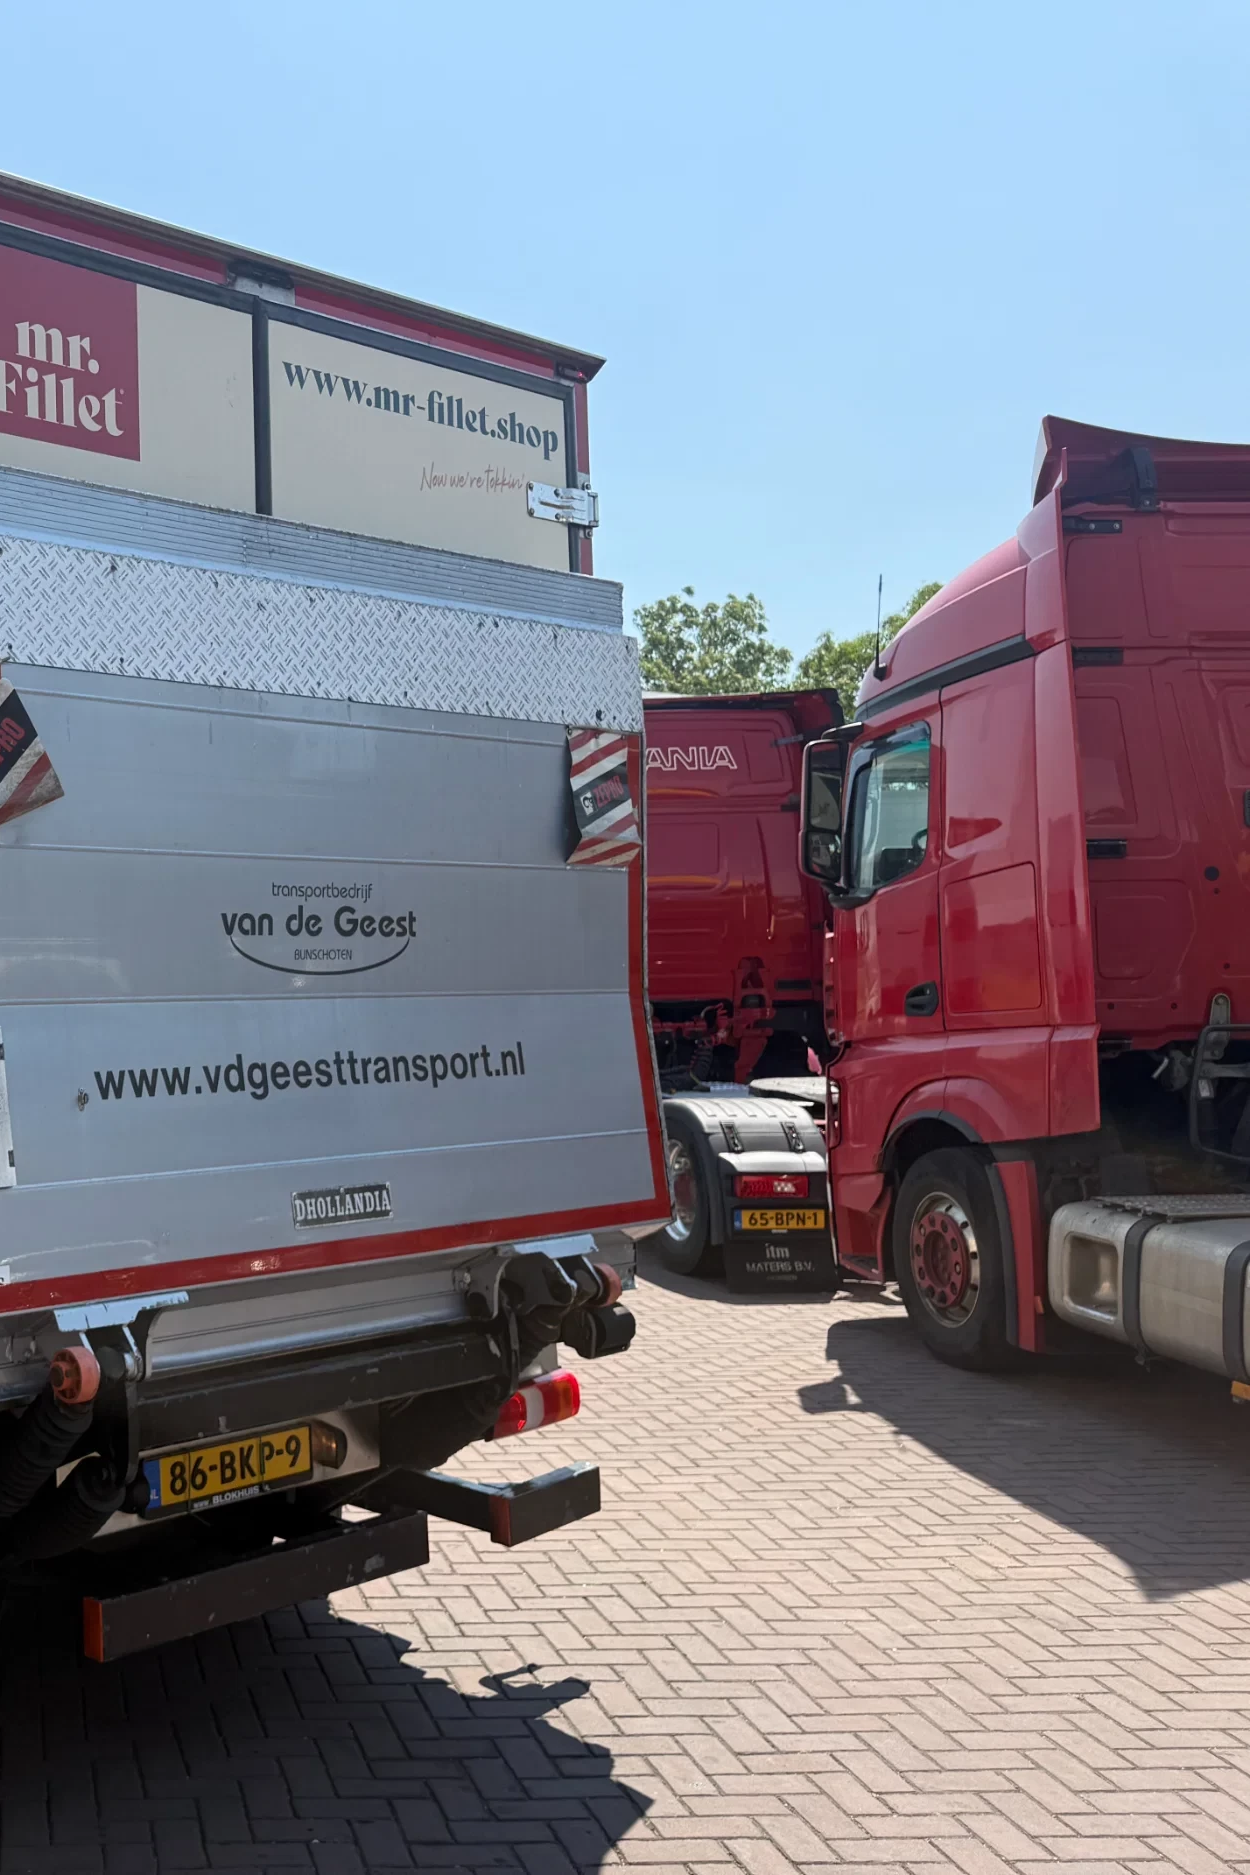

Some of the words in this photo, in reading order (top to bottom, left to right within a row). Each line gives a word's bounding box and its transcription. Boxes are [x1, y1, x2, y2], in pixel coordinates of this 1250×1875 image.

[15, 321, 100, 374] mr.
[282, 361, 559, 461] www.mr-fillet.shop
[646, 746, 738, 771] ANIA
[593, 775, 624, 808] ZEPRO
[272, 881, 373, 903] transportbedrijf
[221, 912, 274, 936] van
[285, 905, 323, 937] de
[333, 905, 417, 938] Geest
[294, 949, 353, 961] BUNSCHOTEN
[94, 1041, 526, 1100] www.vdgeesttransport.nl
[294, 1189, 391, 1222] DHOLLANDIA
[748, 1211, 818, 1227] 65-BPN-1
[169, 1434, 302, 1497] 86-BKP-9
[211, 1484, 260, 1505] BLOKHUIS
